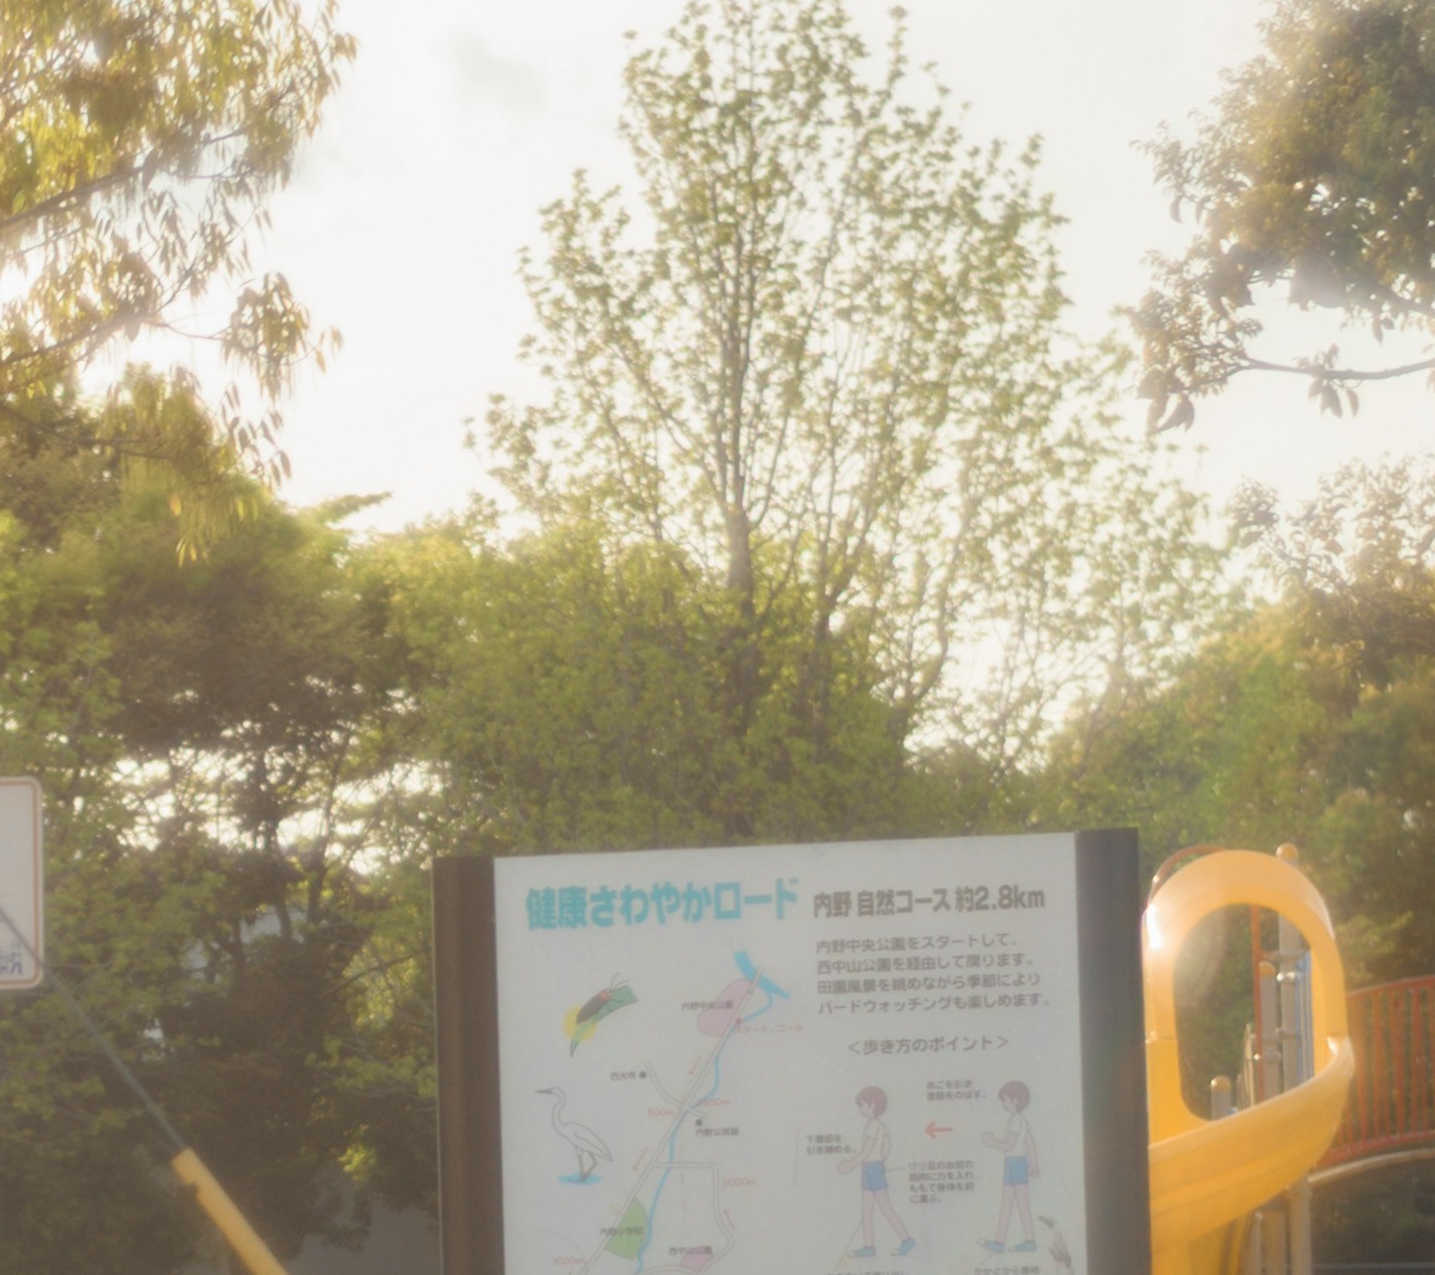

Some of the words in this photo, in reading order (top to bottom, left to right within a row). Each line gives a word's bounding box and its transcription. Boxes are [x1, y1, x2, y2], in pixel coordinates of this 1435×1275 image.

[525, 877, 799, 932] 健康さわやかロード
[813, 891, 851, 918] 内野
[857, 887, 951, 917] 自然コース
[954, 884, 1045, 913] 約2.8km
[816, 951, 1034, 975] 西中山公園を経由して戻ります。
[817, 972, 1041, 995] 田園風景を眺めながら季節により
[818, 992, 1050, 1015] バードウォッチングも楽しめます。
